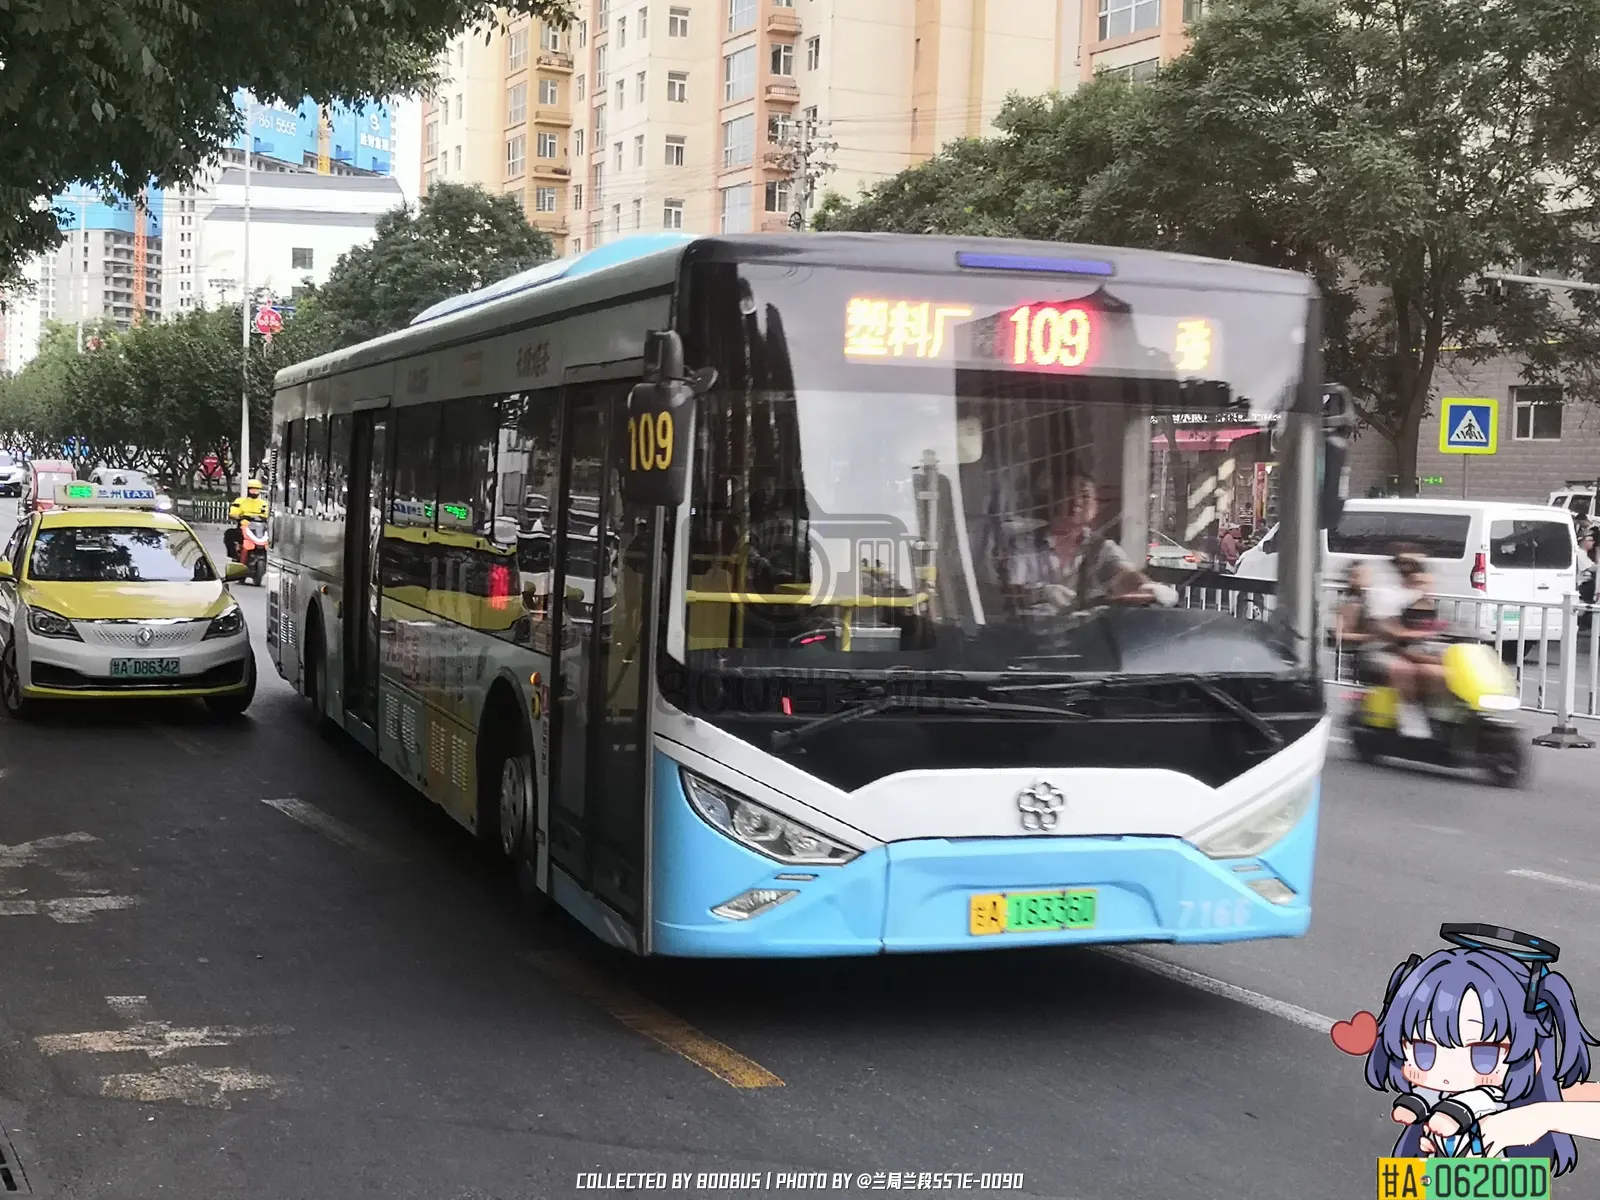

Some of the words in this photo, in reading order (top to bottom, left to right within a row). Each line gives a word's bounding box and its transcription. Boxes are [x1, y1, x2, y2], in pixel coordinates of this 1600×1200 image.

[844, 298, 973, 358] 塑料厂
[1009, 306, 1090, 367] 109
[628, 410, 674, 471] 109
[98, 490, 121, 498] 兰州
[124, 490, 154, 499] TAXI
